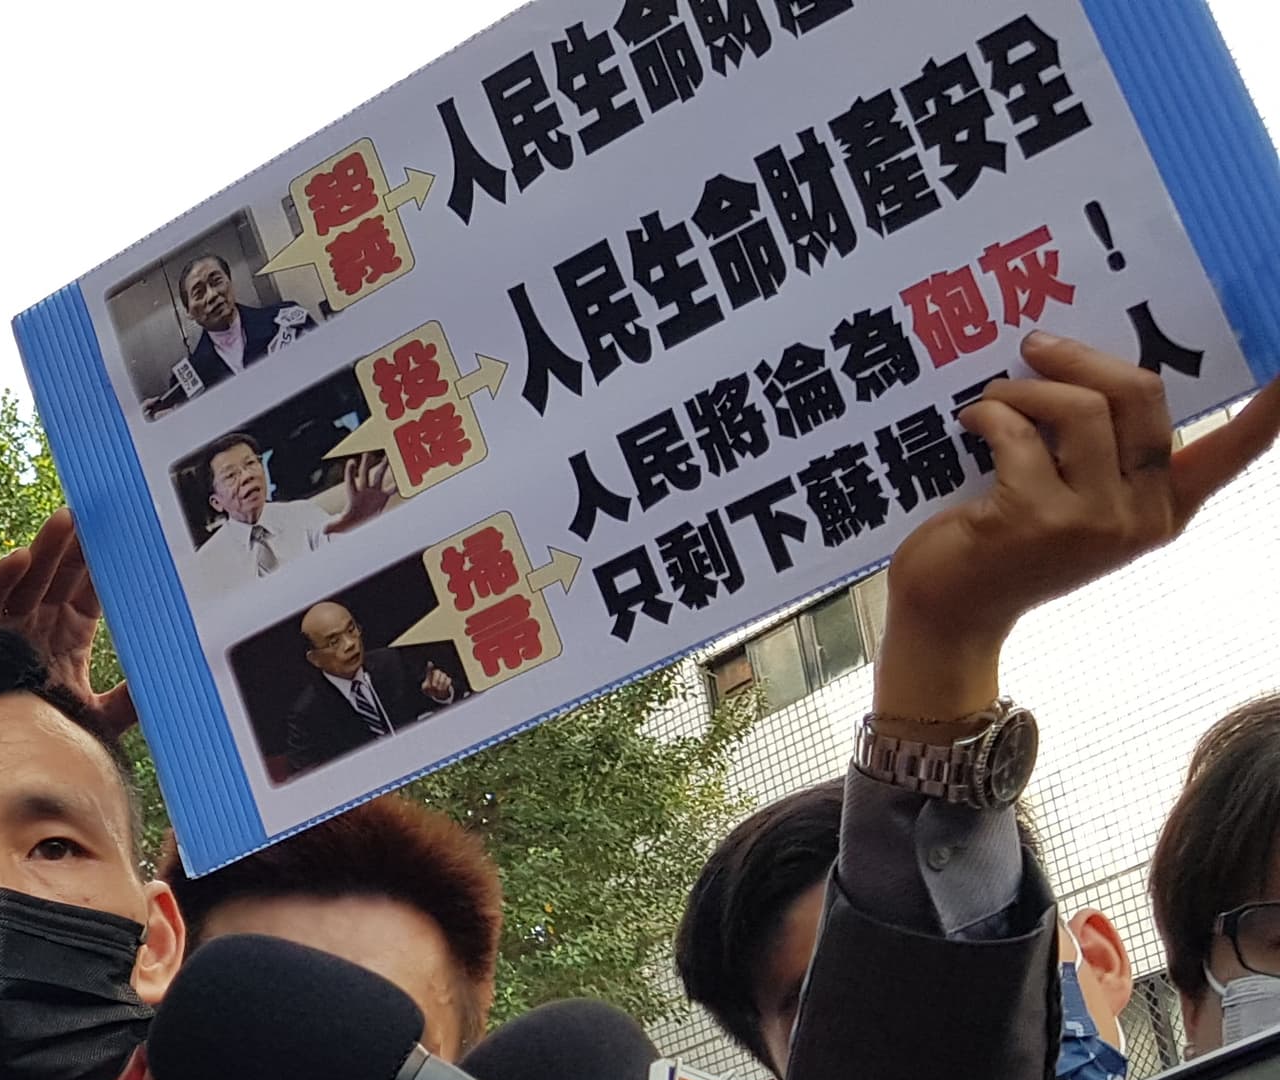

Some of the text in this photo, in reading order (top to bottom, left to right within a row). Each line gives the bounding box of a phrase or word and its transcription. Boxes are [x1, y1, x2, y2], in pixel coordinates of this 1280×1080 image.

[305, 153, 402, 294] 起義
[508, 12, 1091, 416] 人民生命財產安全
[372, 339, 470, 486] 投降
[441, 527, 542, 677] 掃帚
